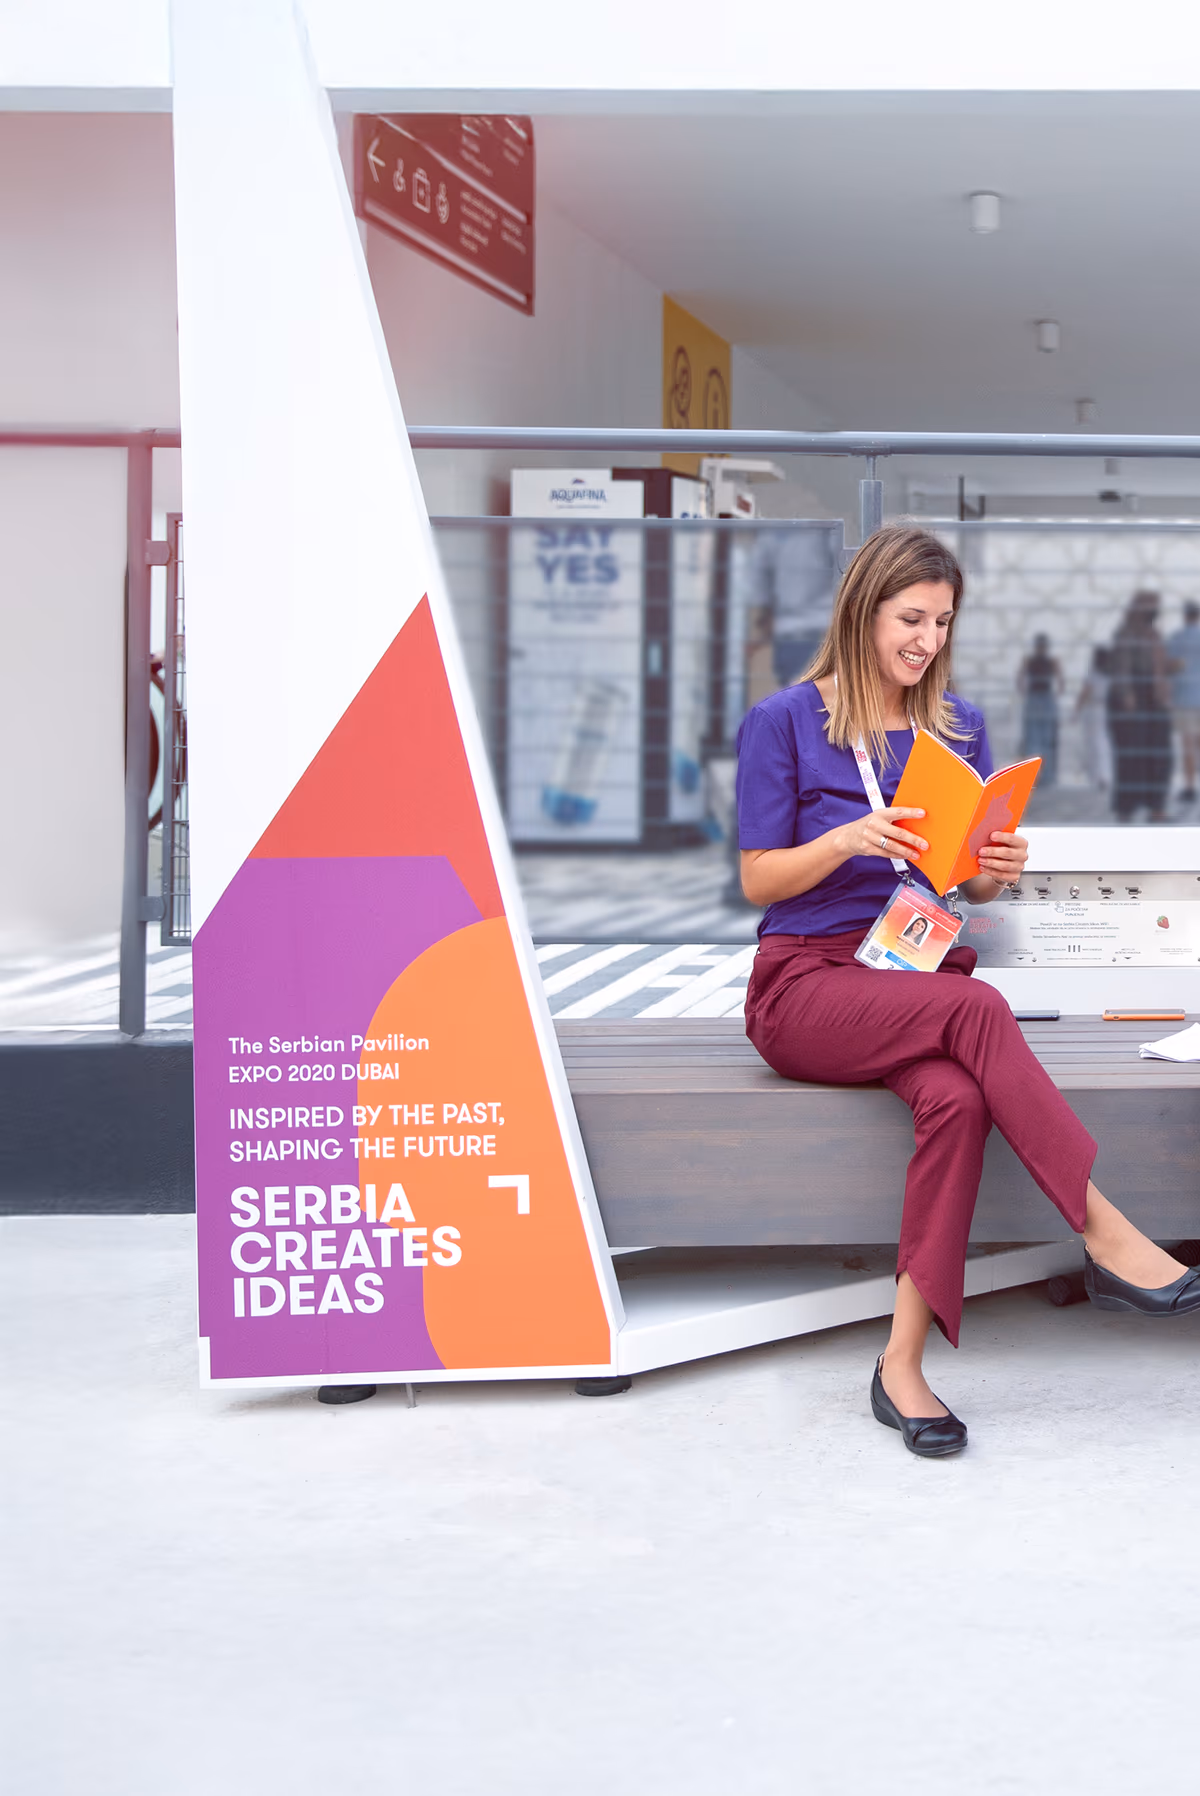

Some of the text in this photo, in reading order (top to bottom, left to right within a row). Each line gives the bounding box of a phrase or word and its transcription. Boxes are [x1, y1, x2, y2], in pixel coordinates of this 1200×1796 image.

[550, 489, 607, 502] AQUAFINA
[535, 523, 615, 549] SAY
[536, 553, 620, 584] YES
[228, 1033, 429, 1054] The Serbian Pavilion
[229, 1062, 400, 1083] EXPO 2020 DUBAI
[230, 1102, 505, 1130] INSPIRED BY THE PAST,
[229, 1134, 496, 1162] SHAPING THE FUTURE
[230, 1182, 416, 1228] SERBIA
[230, 1225, 462, 1273] CREATES
[233, 1272, 385, 1318] IDEAS
